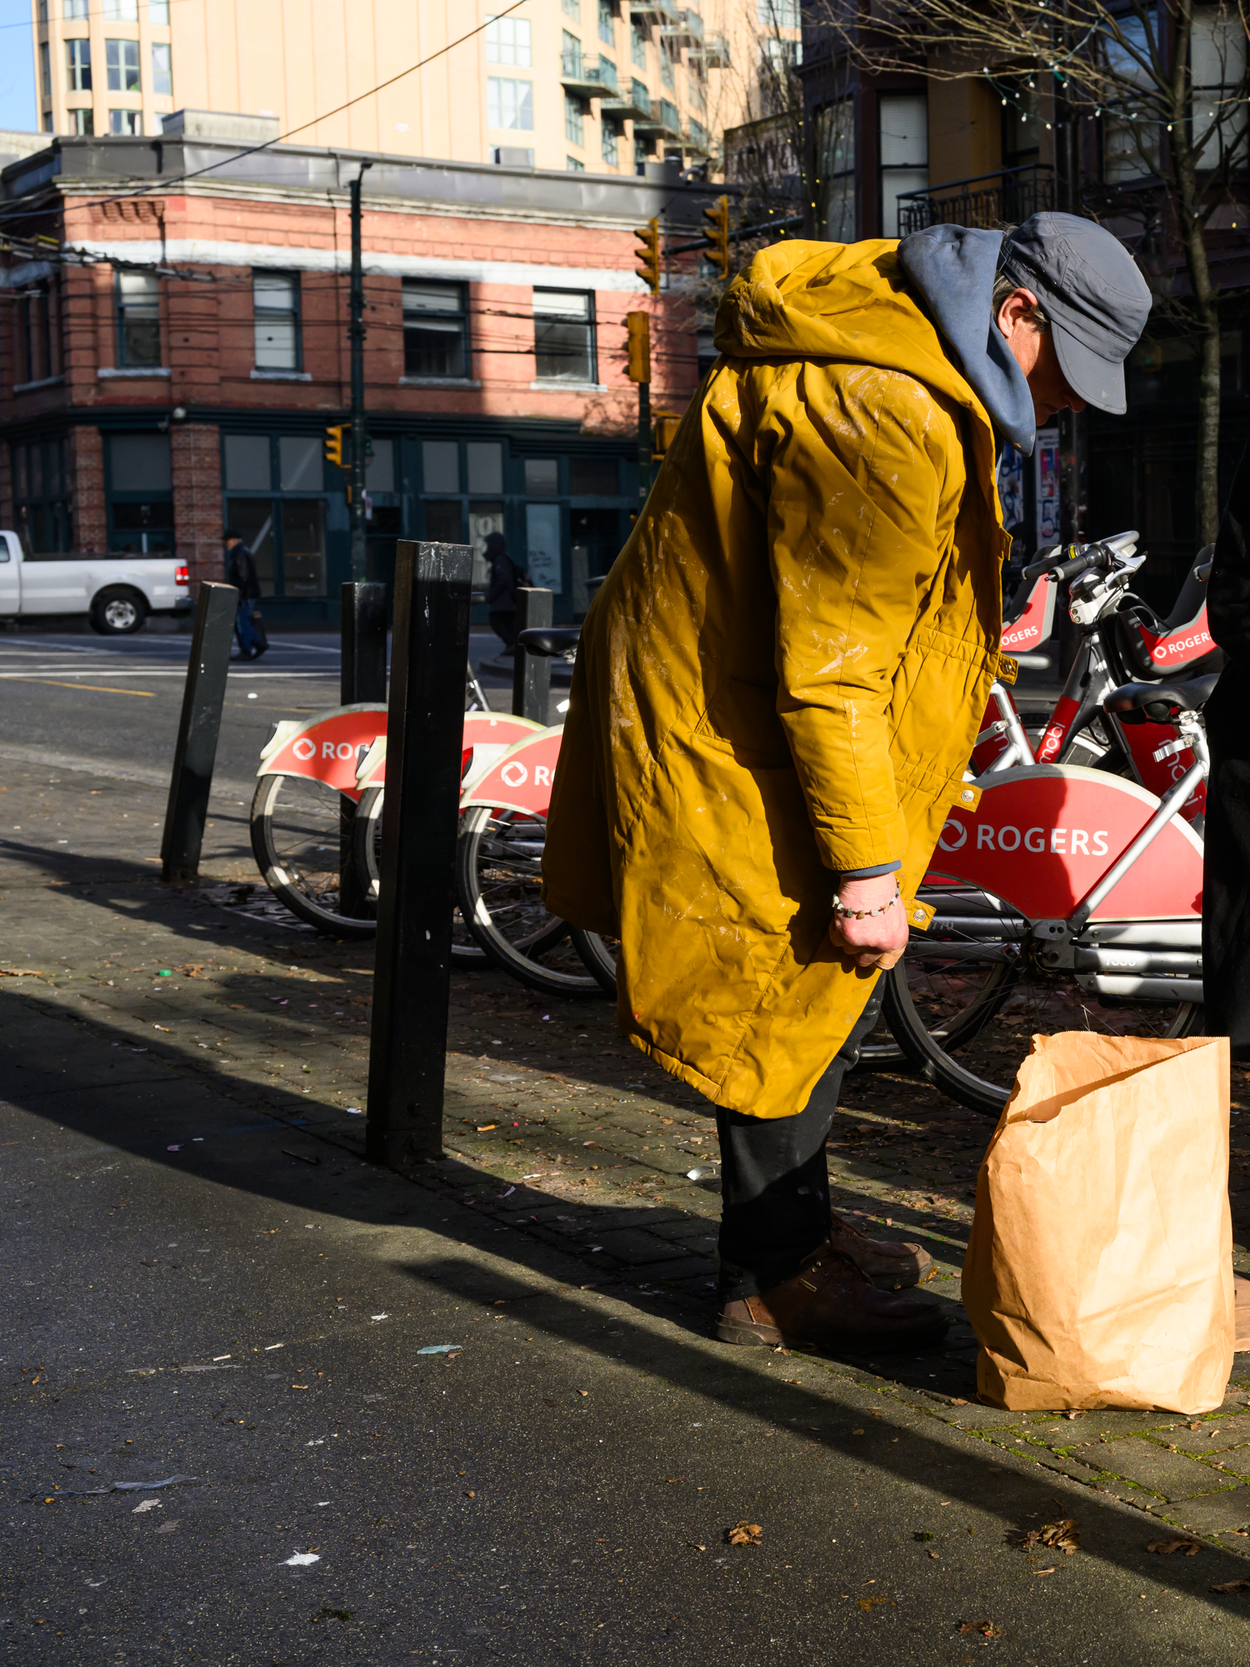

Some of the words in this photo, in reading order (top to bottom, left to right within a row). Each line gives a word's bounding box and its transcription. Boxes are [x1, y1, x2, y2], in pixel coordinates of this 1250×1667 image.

[1001, 625, 1039, 648] OGERS
[1038, 721, 1066, 765] mobi
[1158, 738, 1203, 806] moi
[976, 824, 1109, 856] ROGERS
